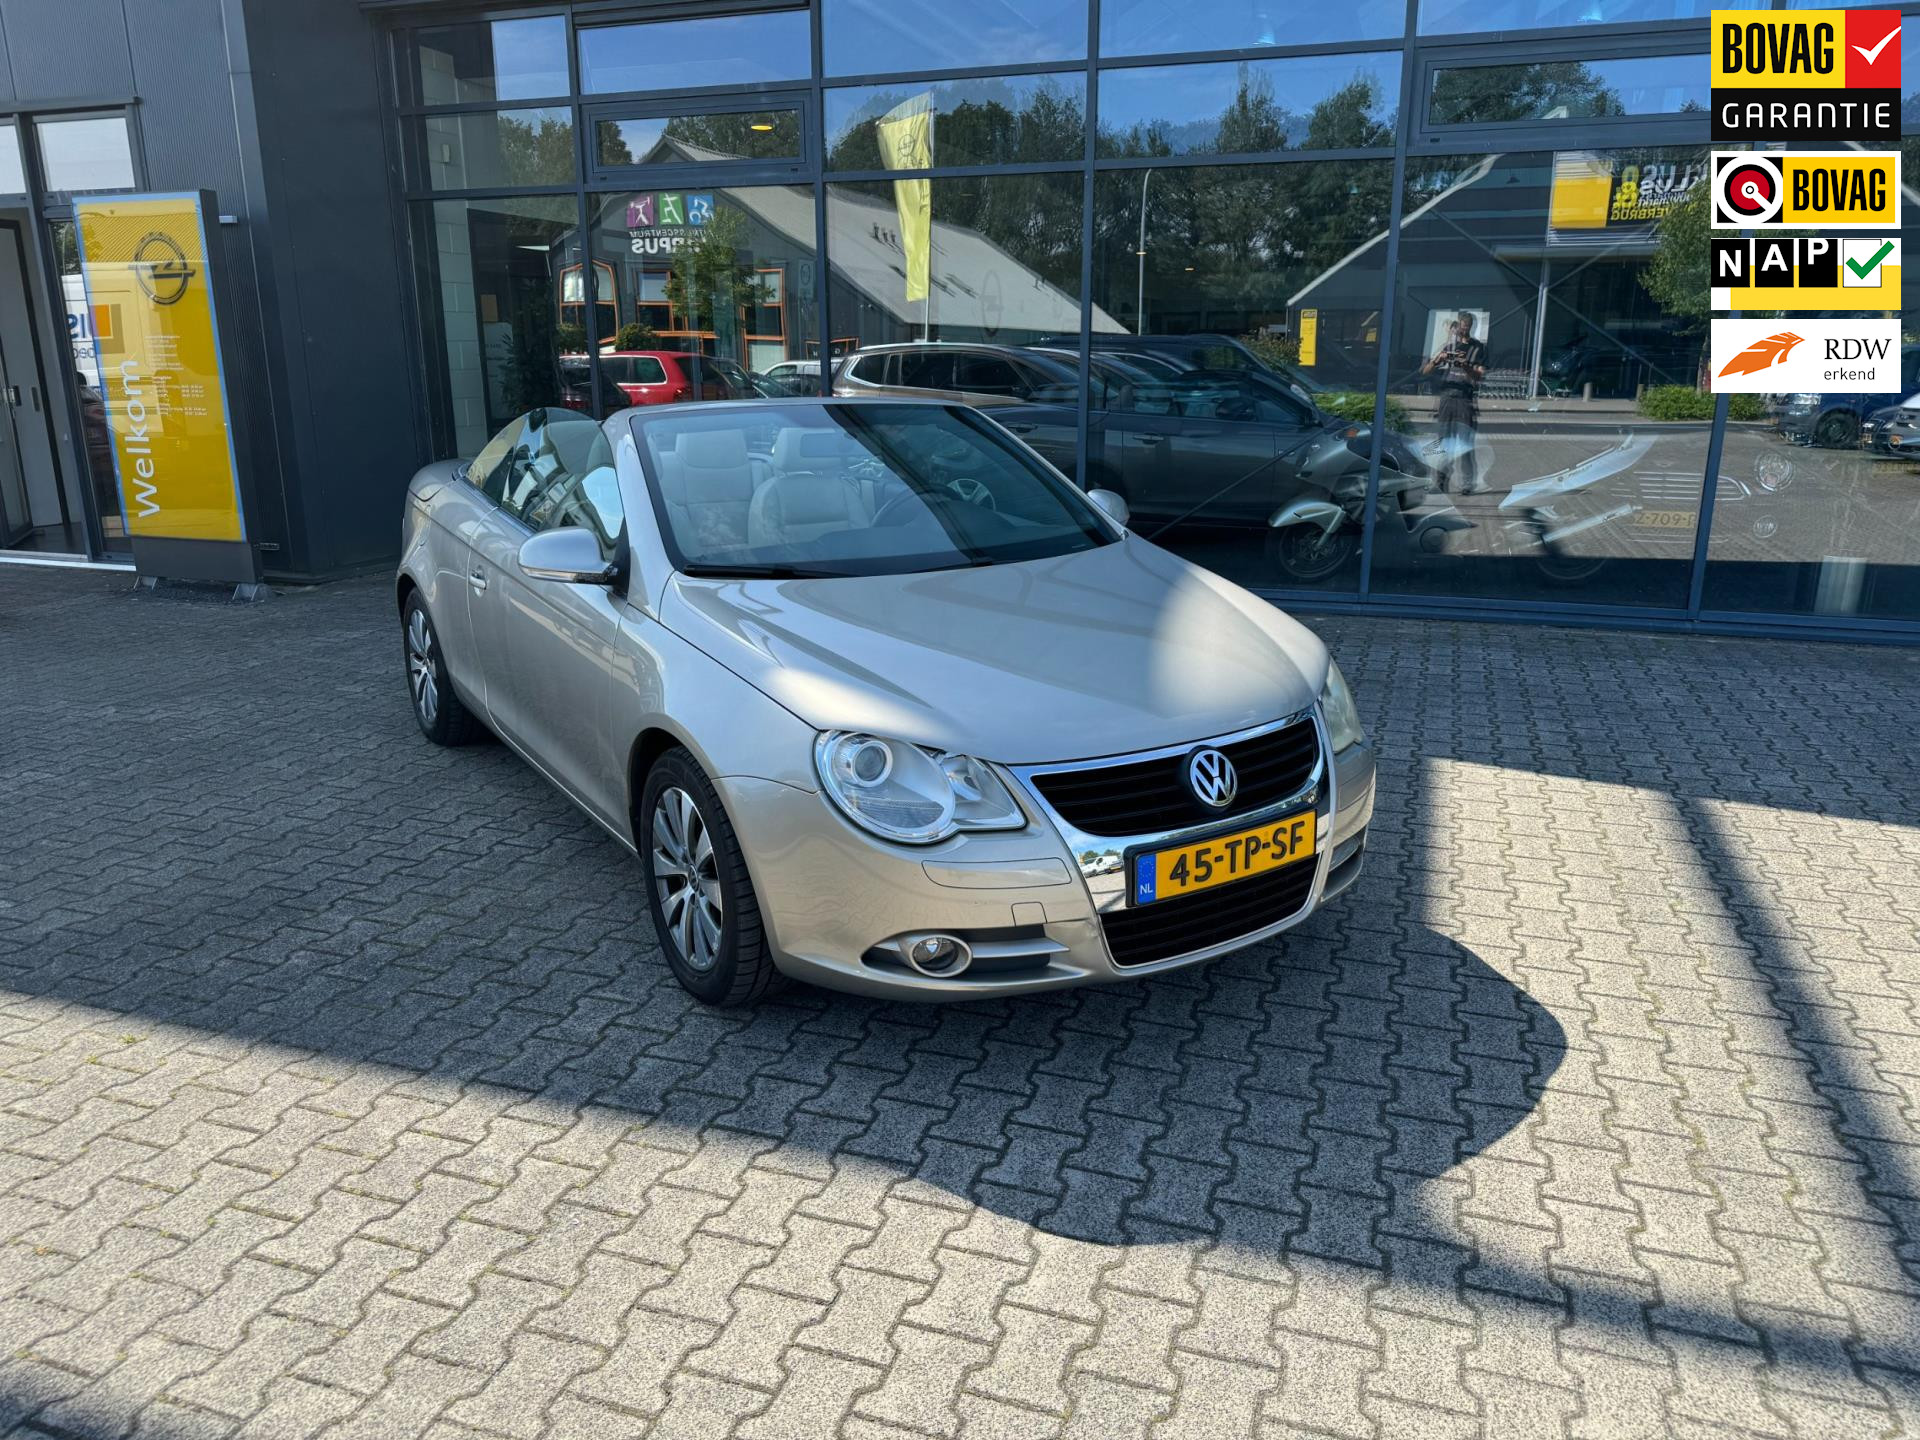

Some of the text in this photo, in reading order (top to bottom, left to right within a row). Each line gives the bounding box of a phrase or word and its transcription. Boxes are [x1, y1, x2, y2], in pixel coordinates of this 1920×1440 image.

[120, 360, 161, 518] Welkom
[1632, 511, 1696, 527] Z-709-
[1169, 820, 1305, 887] 45-TP-SF
[1140, 884, 1153, 894] NL
